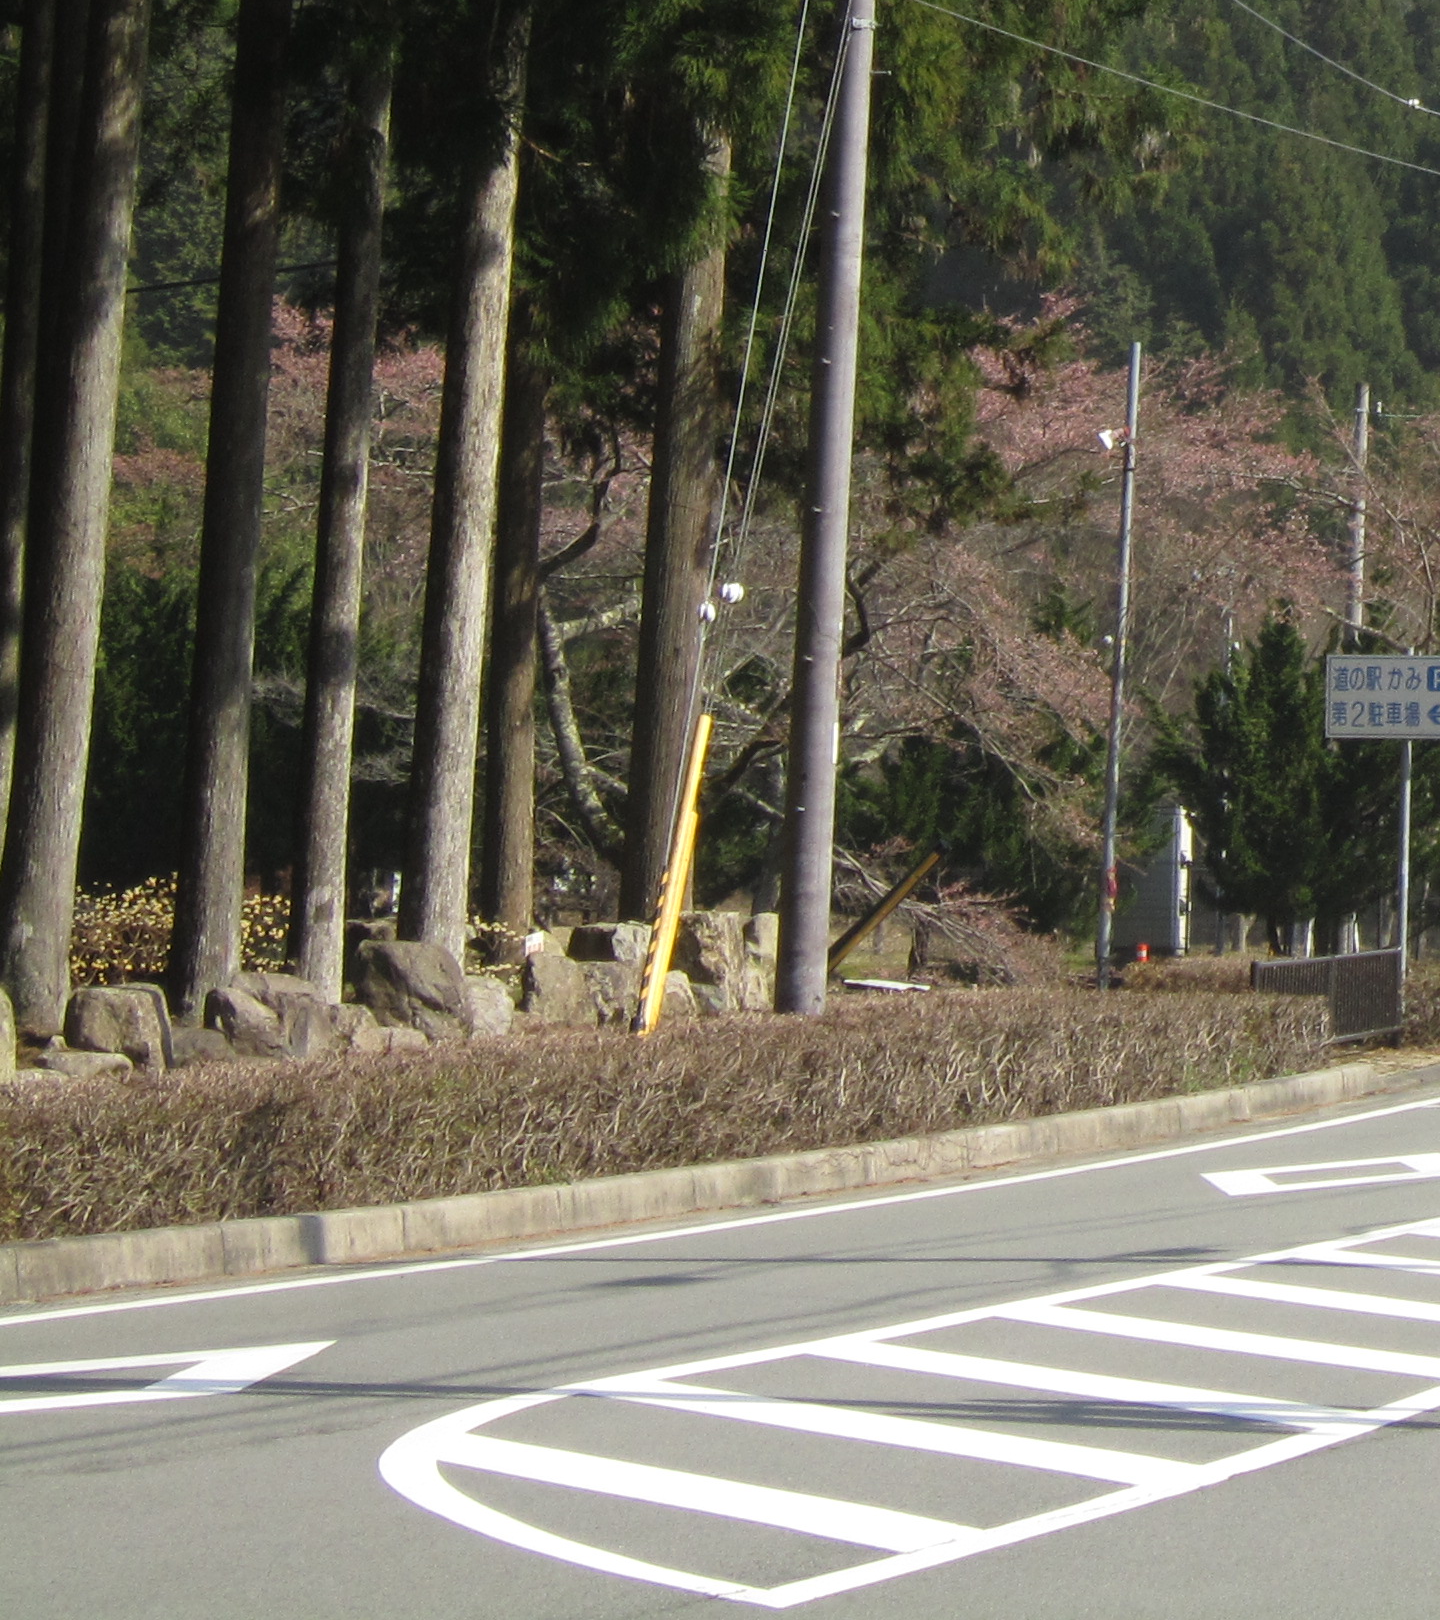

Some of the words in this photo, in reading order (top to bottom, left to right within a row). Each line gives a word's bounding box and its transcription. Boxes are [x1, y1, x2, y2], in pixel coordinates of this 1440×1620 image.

[1331, 666, 1382, 692] 道の駅
[1388, 667, 1422, 691] かみ
